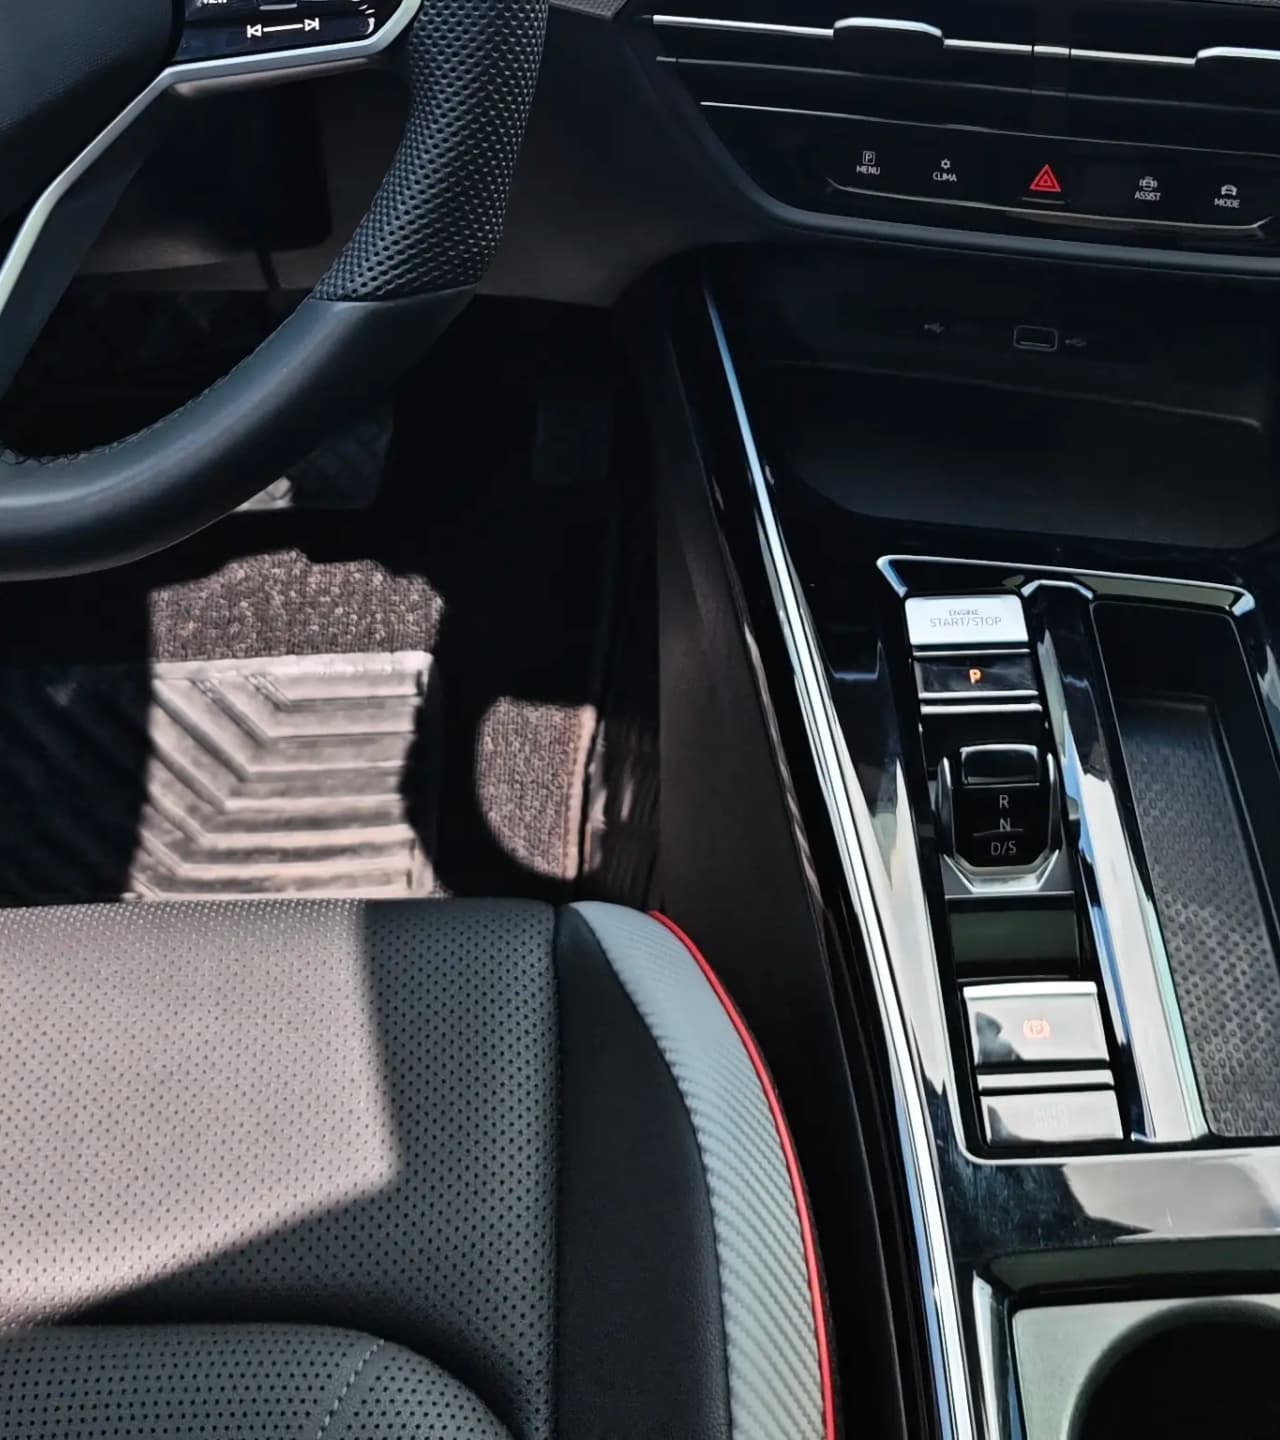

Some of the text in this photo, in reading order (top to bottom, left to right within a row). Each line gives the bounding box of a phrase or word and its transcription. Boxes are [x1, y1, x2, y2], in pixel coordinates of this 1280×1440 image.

[856, 165, 881, 176] MENU
[932, 171, 958, 183] CLIMA
[1134, 190, 1162, 202] ASSIST
[1214, 197, 1241, 209] MODE
[929, 616, 1002, 628] START/STOP
[968, 668, 982, 685] P
[999, 794, 1010, 809] R
[999, 816, 1011, 832] N
[990, 840, 1017, 856] D/S
